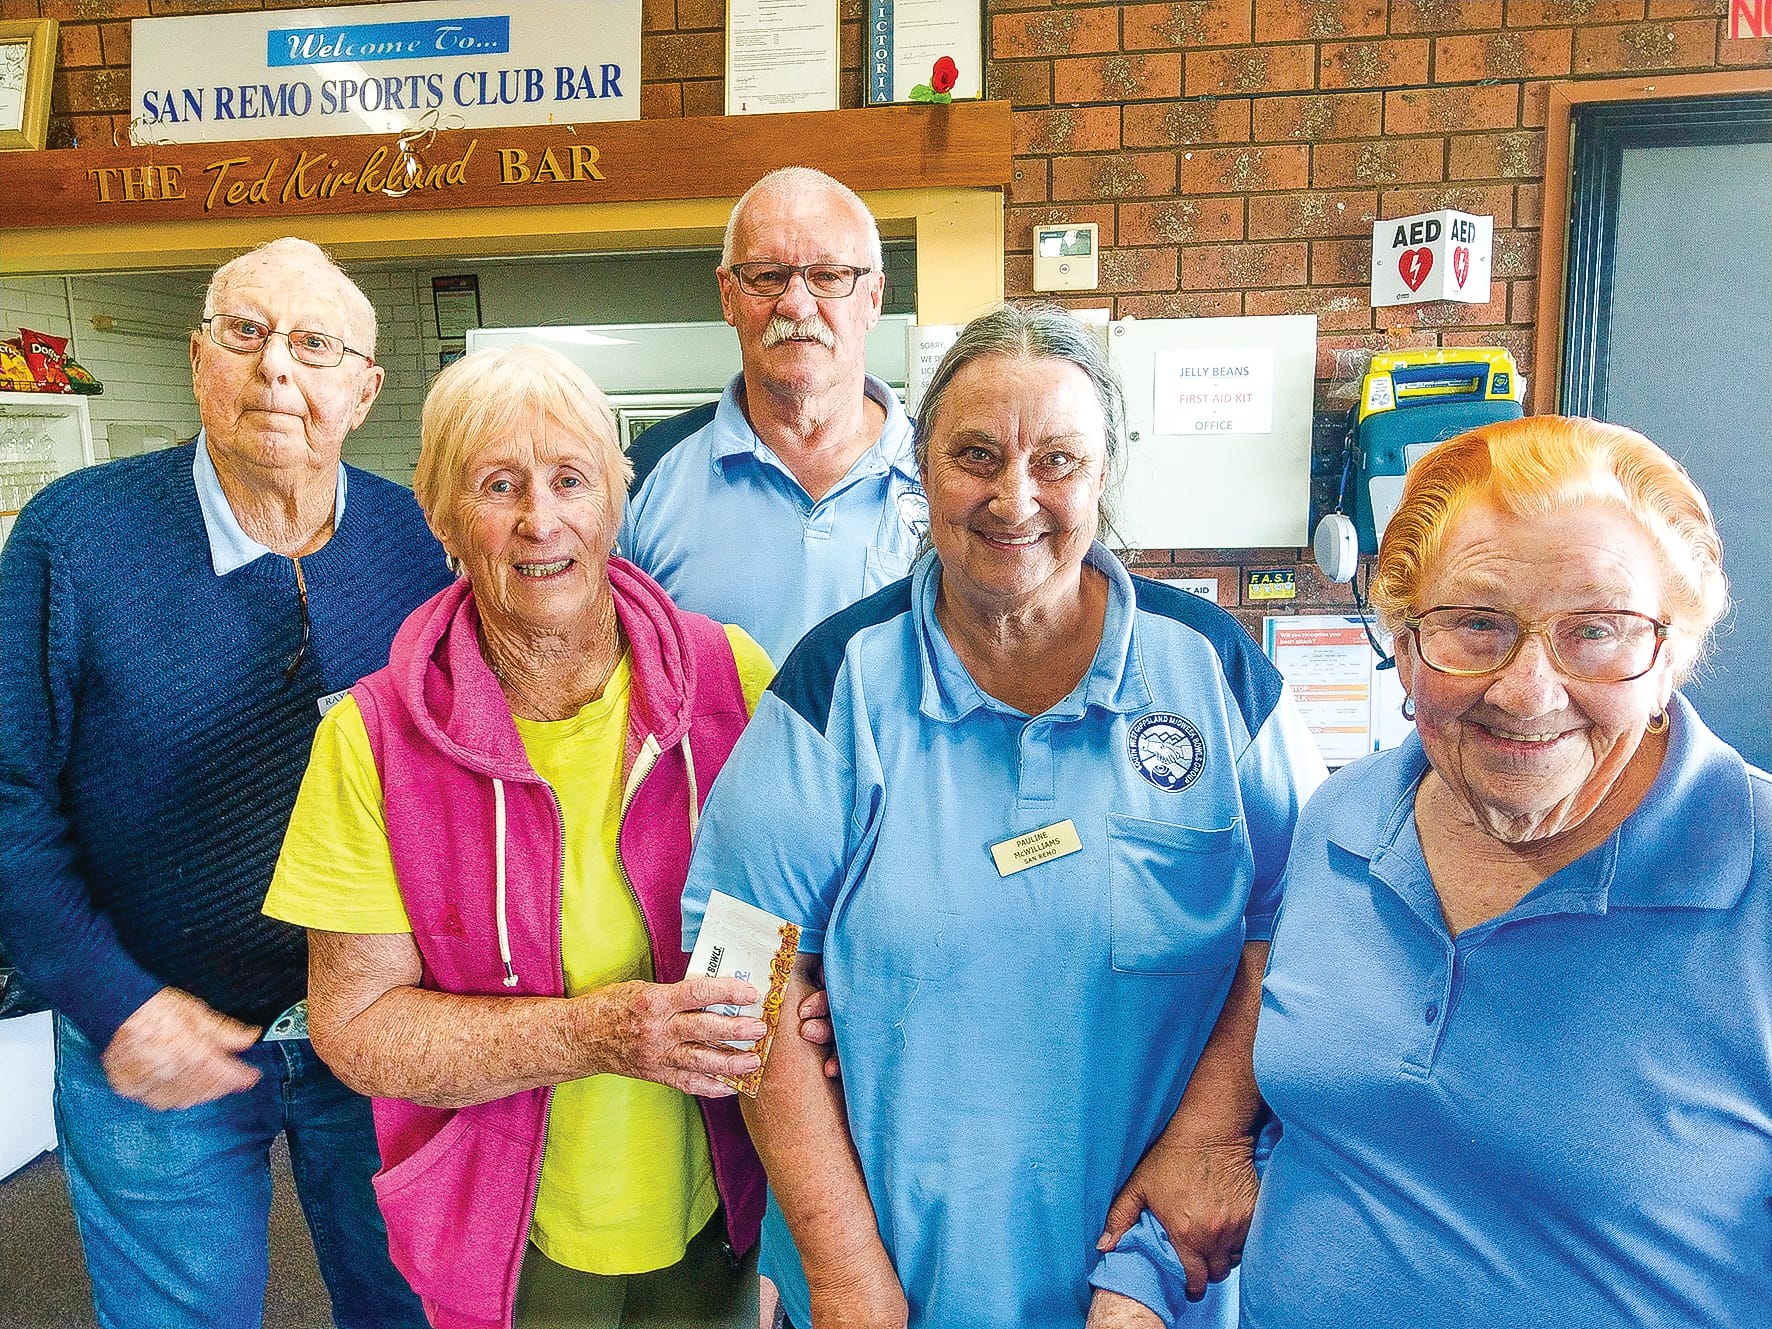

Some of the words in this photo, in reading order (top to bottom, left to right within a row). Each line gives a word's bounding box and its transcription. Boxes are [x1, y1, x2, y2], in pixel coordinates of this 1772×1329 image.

[1731, 0, 1772, 40] N
[288, 33, 421, 60] Welcome
[434, 26, 498, 51] To...
[143, 88, 204, 125] SAN
[213, 82, 312, 120] REMO
[320, 73, 443, 116] SPORTS
[453, 67, 544, 107] CLUB
[553, 64, 624, 101] BAR
[87, 165, 187, 204] THE
[203, 157, 279, 212] Ted
[280, 139, 478, 205] Kirkland
[497, 145, 606, 186] BAR
[1392, 219, 1442, 248] AED
[1451, 218, 1476, 243] AED
[1179, 367, 1209, 378] JELLY
[1212, 366, 1250, 377] BEANS
[1179, 394, 1209, 404] FIRST
[1212, 393, 1232, 404] AID
[1235, 393, 1253, 403] KIT
[1194, 420, 1233, 431] OFFICE
[1193, 586, 1210, 594] AID
[1129, 730, 1138, 746] WEST
[1192, 738, 1203, 761] BOWLS
[1184, 761, 1202, 784] GROUP
[1013, 837, 1061, 859] McWILLIAMS
[1016, 831, 1049, 848] PAULINE
[1023, 855, 1038, 865] SAN
[1039, 848, 1057, 860] REMO
